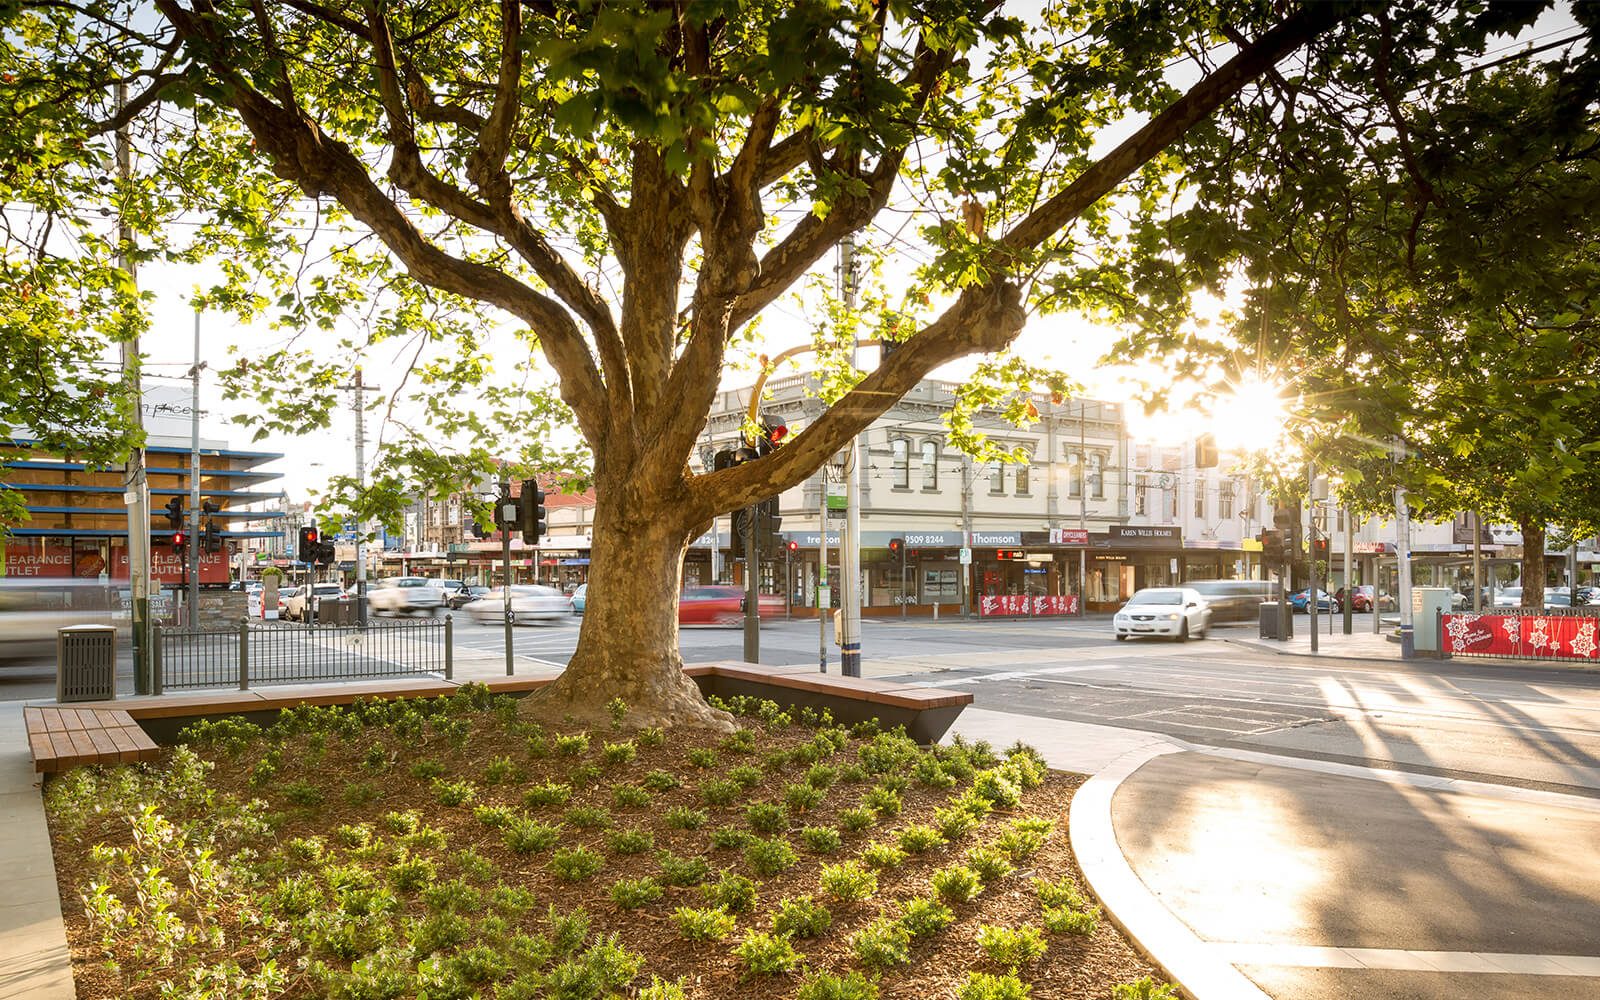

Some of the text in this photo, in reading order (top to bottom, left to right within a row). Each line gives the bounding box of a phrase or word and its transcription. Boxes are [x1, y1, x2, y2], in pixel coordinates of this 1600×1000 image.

[905, 535, 944, 544] 9509 8244
[972, 533, 1015, 544] Thomson
[1466, 633, 1492, 645] Christmas
